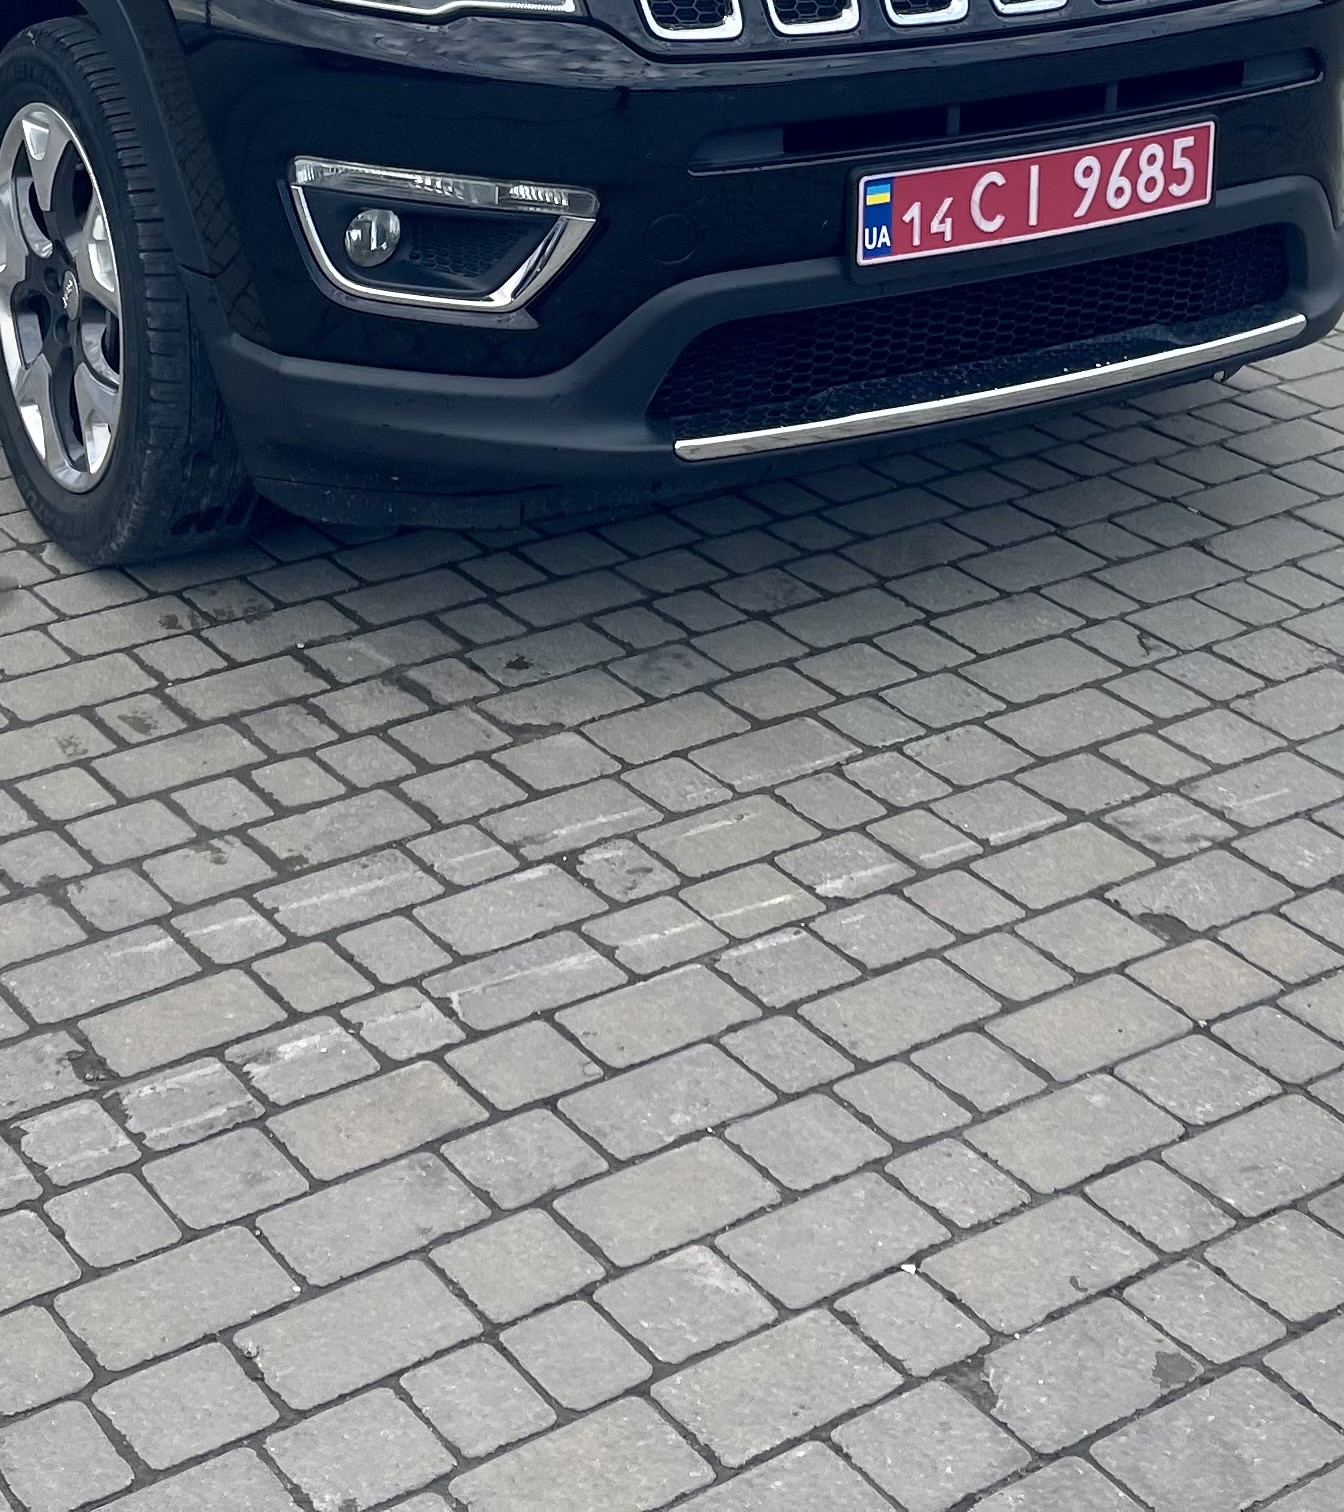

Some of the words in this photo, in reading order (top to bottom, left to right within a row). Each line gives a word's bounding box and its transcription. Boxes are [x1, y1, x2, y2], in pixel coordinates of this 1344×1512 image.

[902, 197, 954, 247] 14
[1073, 135, 1196, 219] 9685
[864, 226, 891, 249] UA
